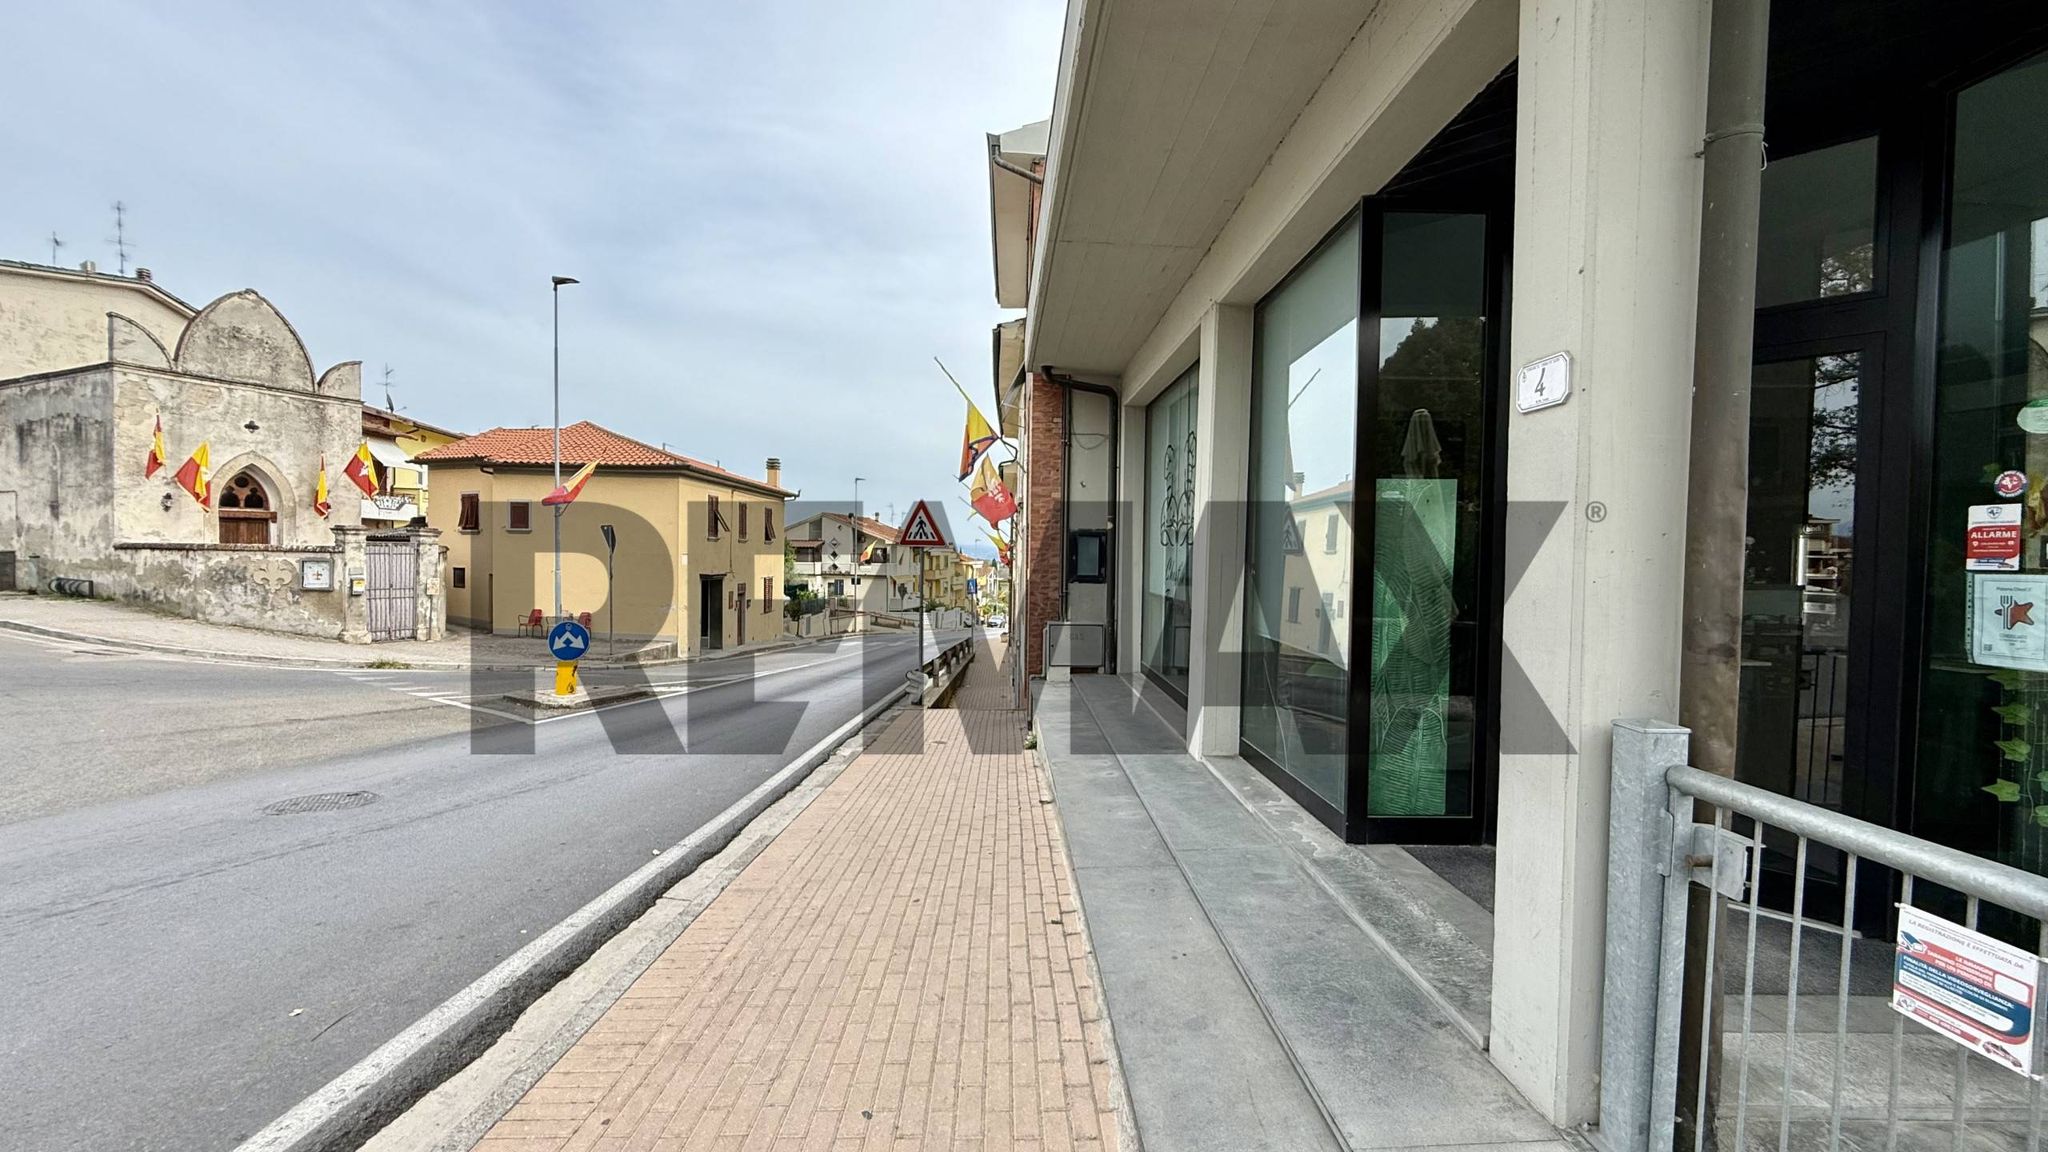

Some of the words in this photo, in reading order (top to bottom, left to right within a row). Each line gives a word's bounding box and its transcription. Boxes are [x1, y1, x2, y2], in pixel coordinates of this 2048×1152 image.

[1534, 367, 1546, 396] 4
[1971, 530, 2017, 539] ALLARME
[1928, 966, 1947, 979] DELLA
